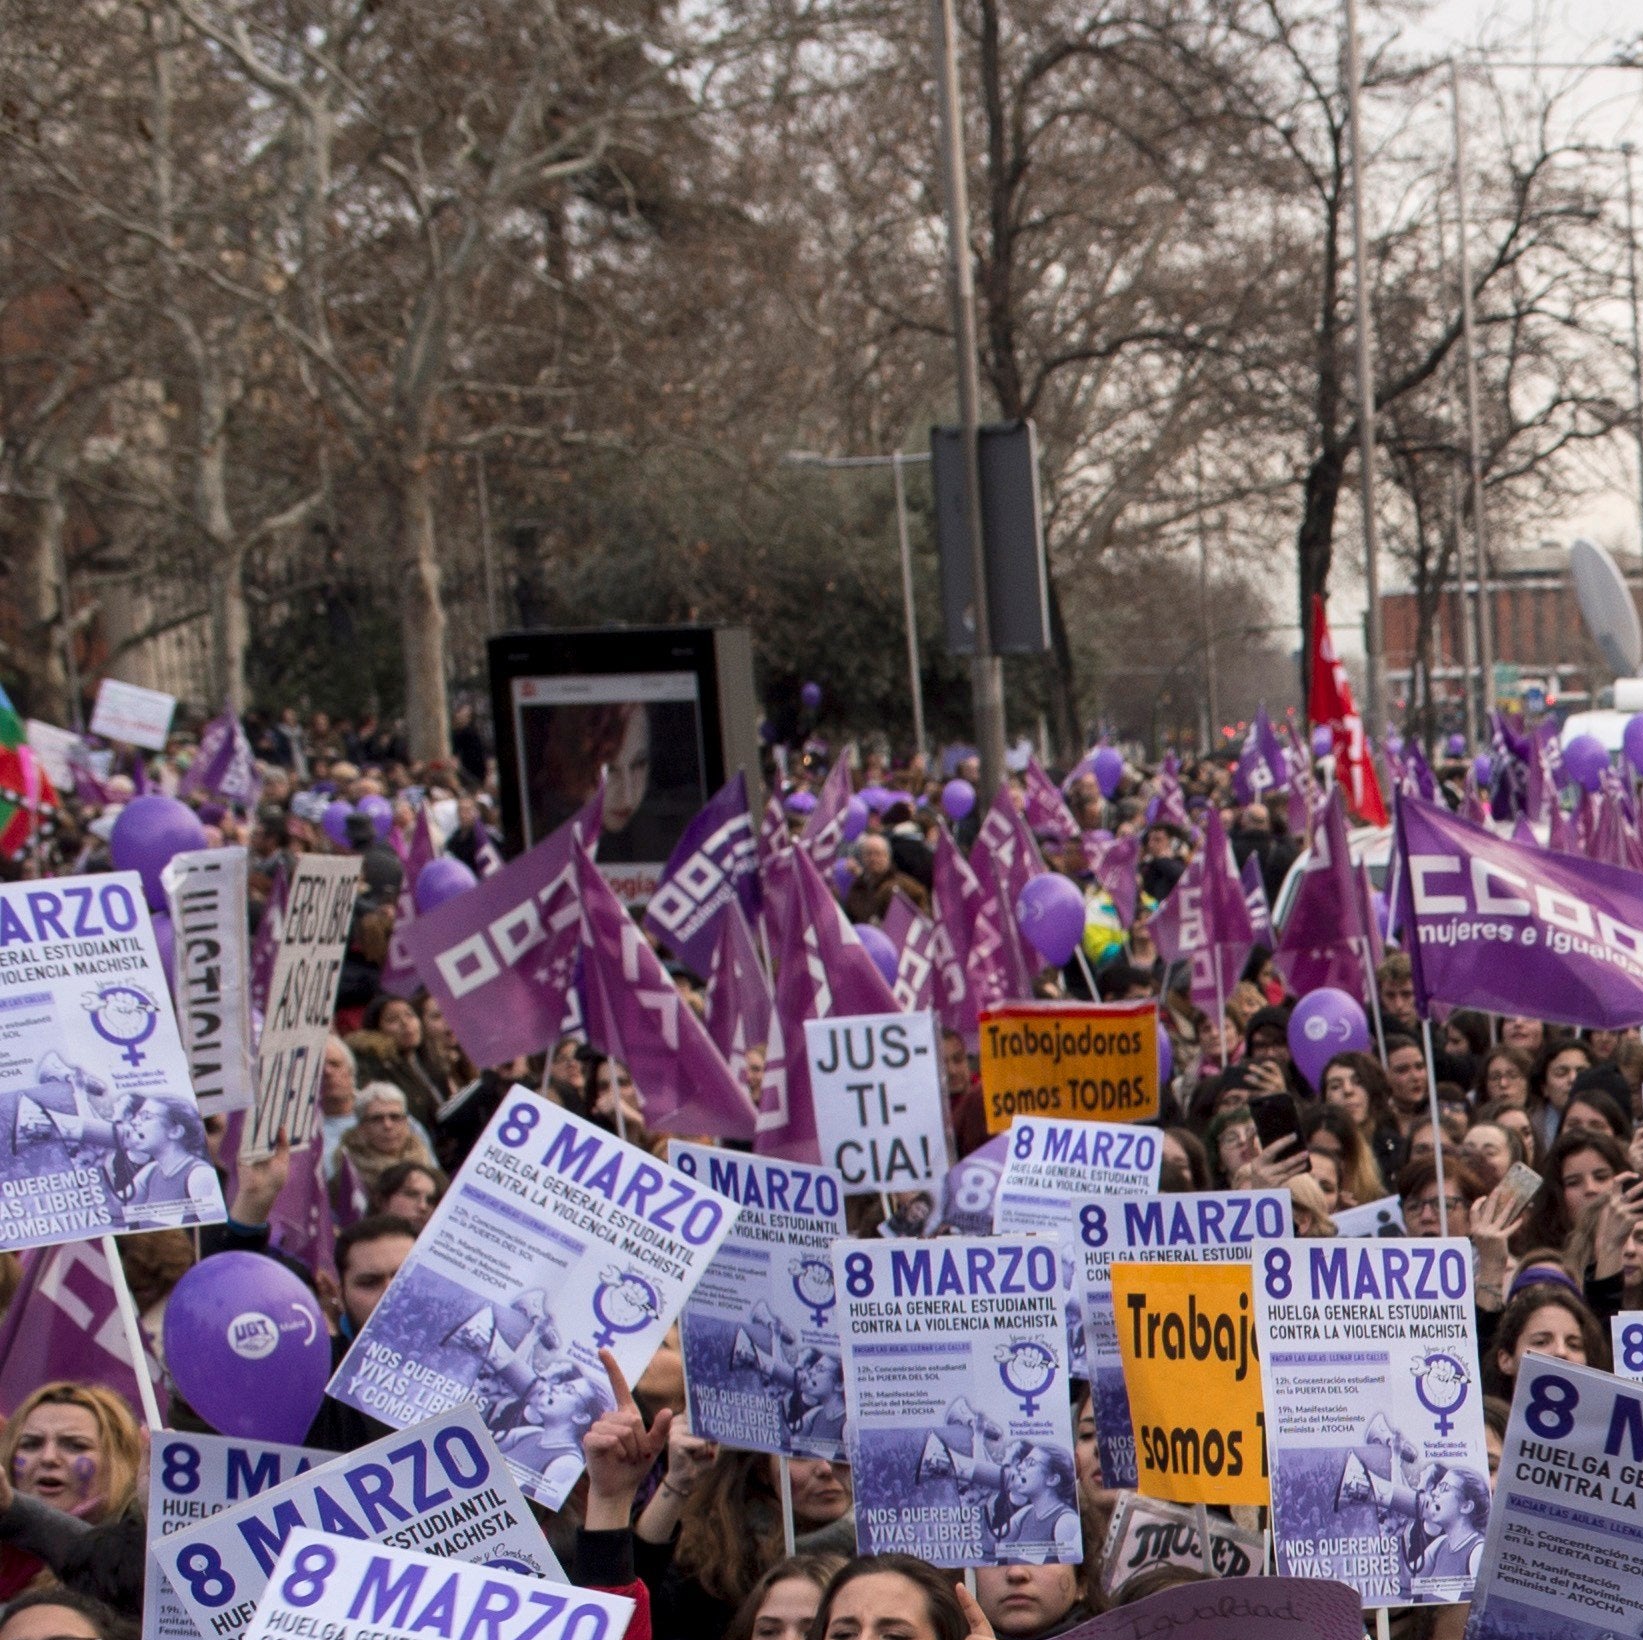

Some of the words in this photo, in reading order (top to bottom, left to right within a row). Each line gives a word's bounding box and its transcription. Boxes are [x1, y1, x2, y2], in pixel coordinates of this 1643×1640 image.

[1417, 918, 1514, 946] mujeres
[1521, 927, 1537, 945] e
[816, 1023, 928, 1074] JUS-
[988, 1021, 1141, 1064] Trabajadoras
[847, 1082, 906, 1127] TI-
[992, 1089, 1060, 1116] somos
[1067, 1077, 1151, 1111] TODAS.
[497, 1098, 539, 1148] 8
[540, 1119, 723, 1245] MARZO
[835, 1135, 933, 1184] CIA!
[1013, 1125, 1034, 1159] 8
[1040, 1127, 1157, 1172] MARZO
[1077, 1203, 1108, 1248] 8
[1122, 1198, 1282, 1246] MARZO
[843, 1251, 874, 1298] 8
[890, 1245, 1056, 1297] MARZO
[1263, 1247, 1292, 1299] 8
[1308, 1247, 1467, 1300] MARZO
[235, 1320, 270, 1341] UGT
[1528, 1381, 1579, 1442] 8
[1141, 1425, 1243, 1477] somos
[280, 1542, 336, 1607] 8
[1129, 1596, 1302, 1640] Igualdad
